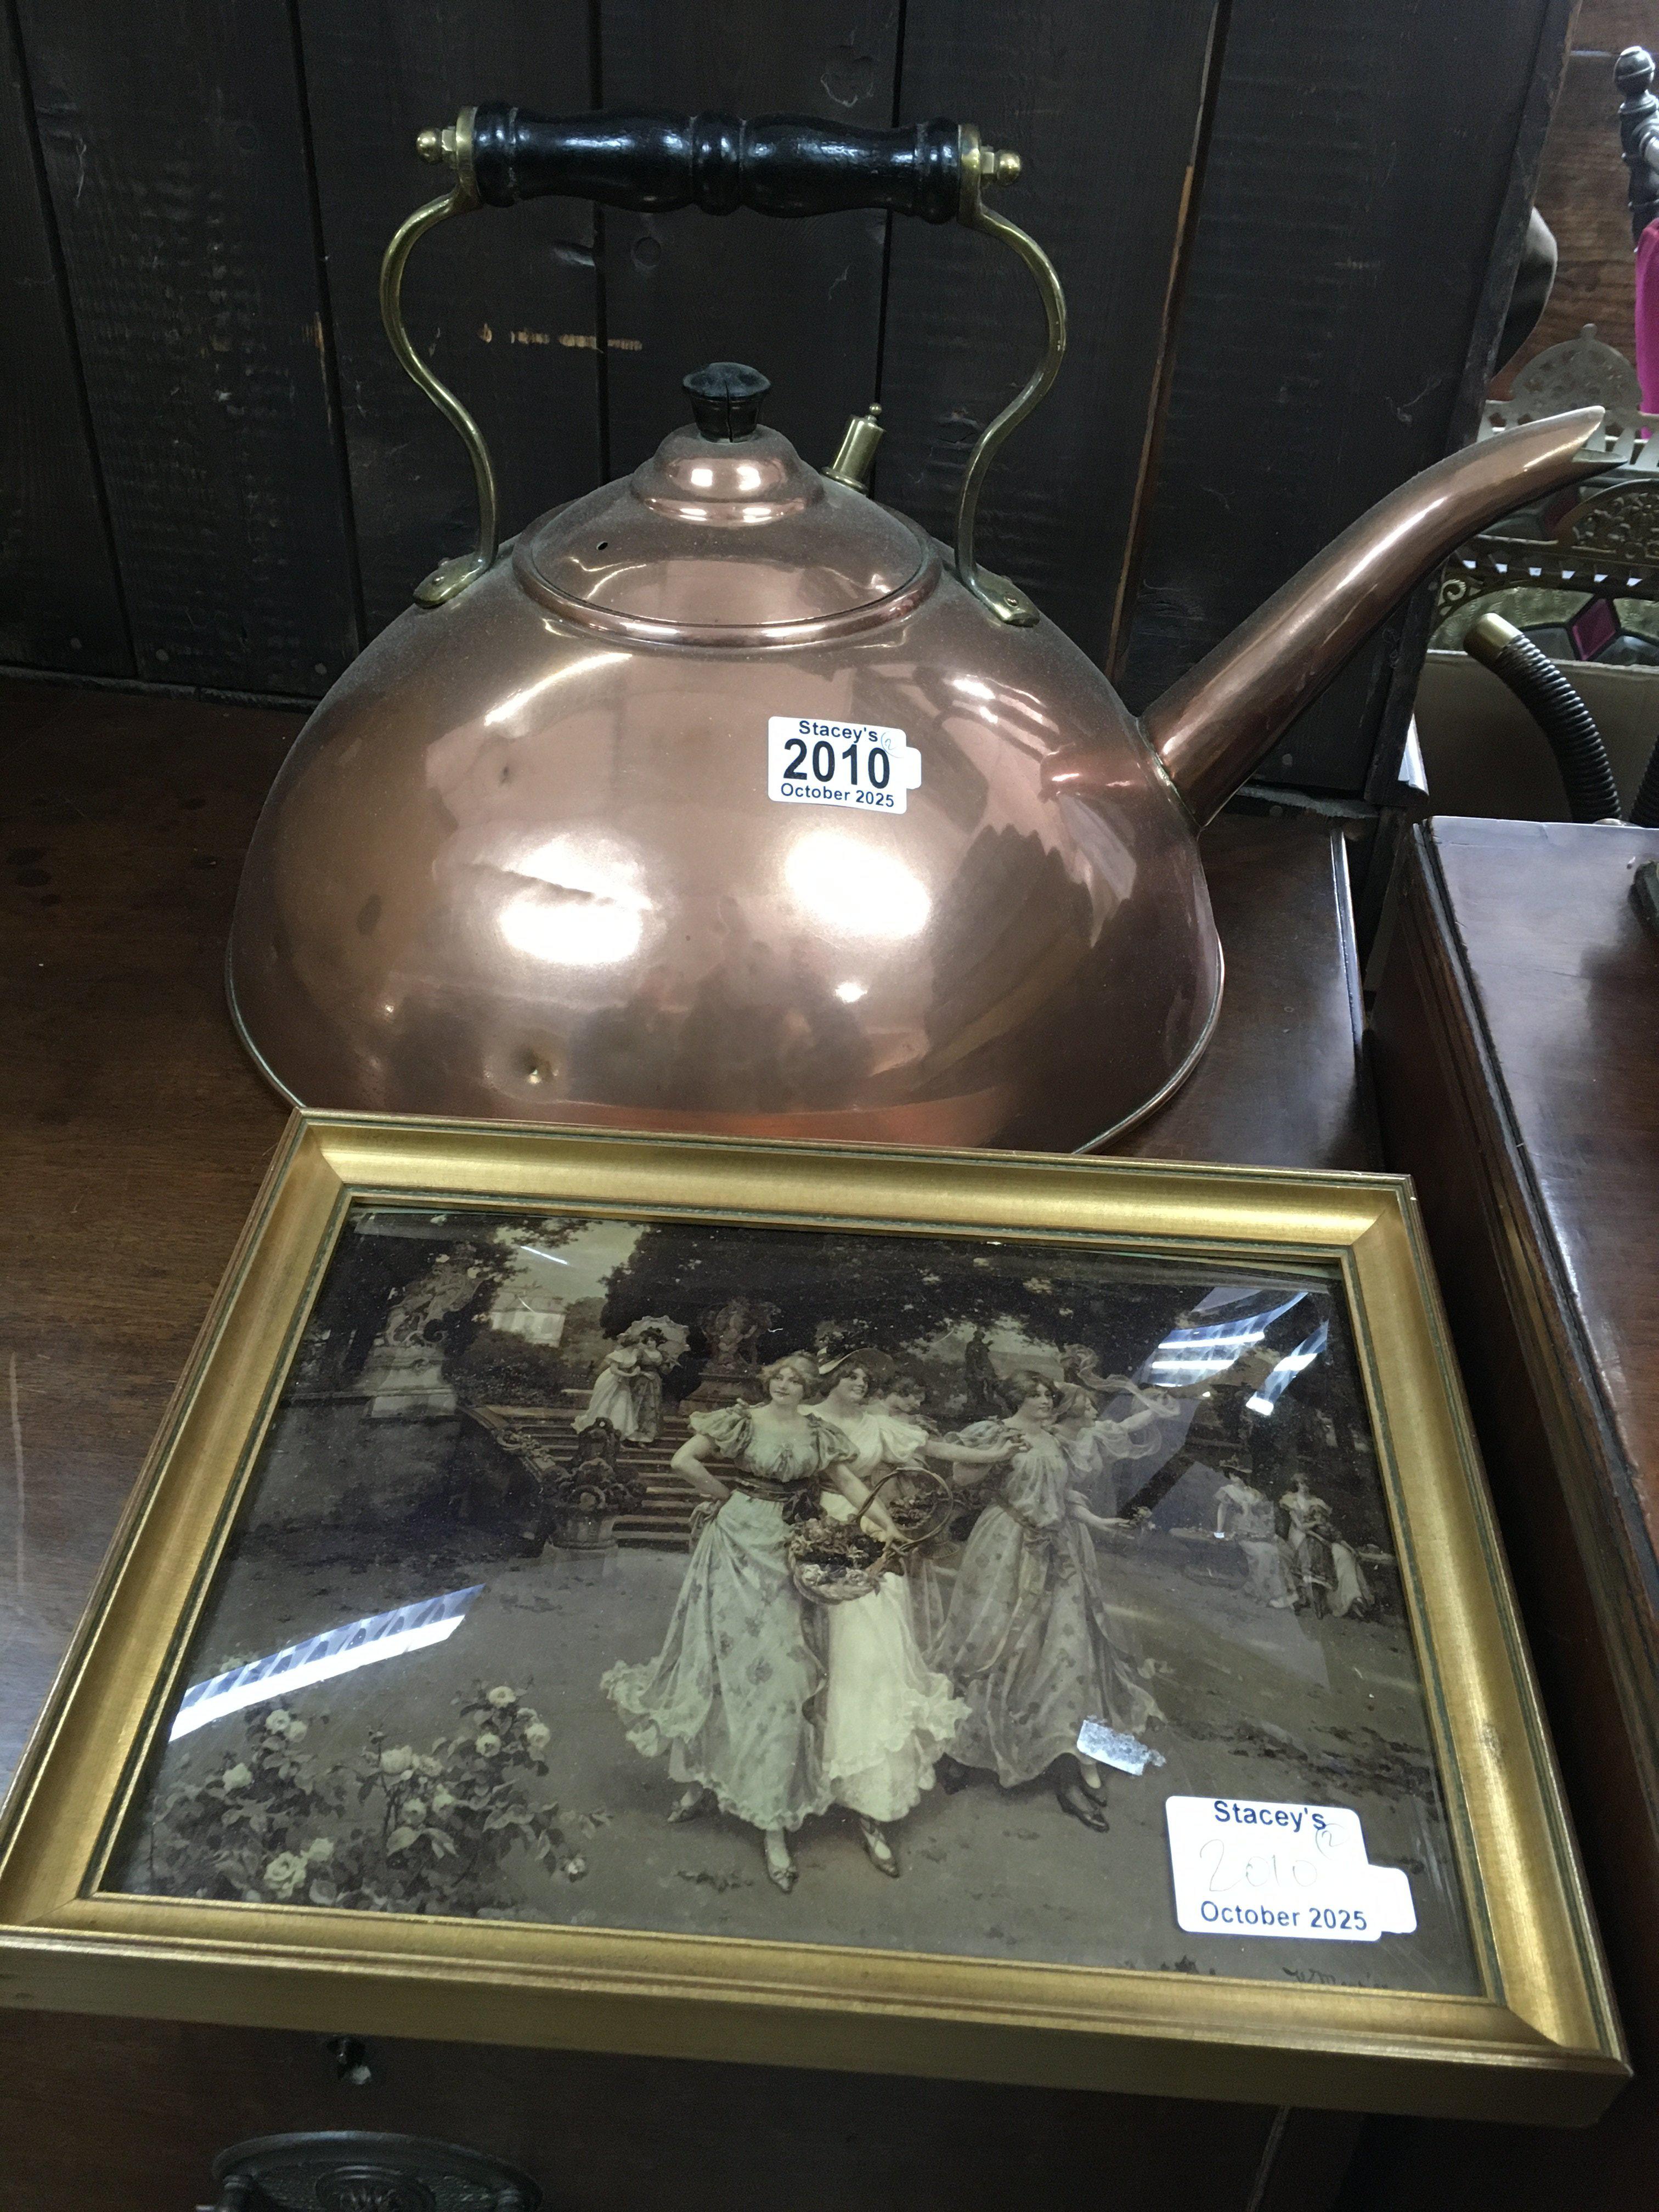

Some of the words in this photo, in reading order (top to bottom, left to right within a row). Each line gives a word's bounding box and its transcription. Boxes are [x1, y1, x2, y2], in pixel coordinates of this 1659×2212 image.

[799, 720, 878, 743] Stacey's
[783, 738, 890, 789] 2010
[781, 783, 850, 800] October
[856, 789, 894, 807] 2025
[1214, 1800, 1327, 1832] Stacey's
[1199, 1839, 1317, 1892] 2010
[1200, 1900, 1300, 1927] October
[1309, 1908, 1367, 1931] 2025
